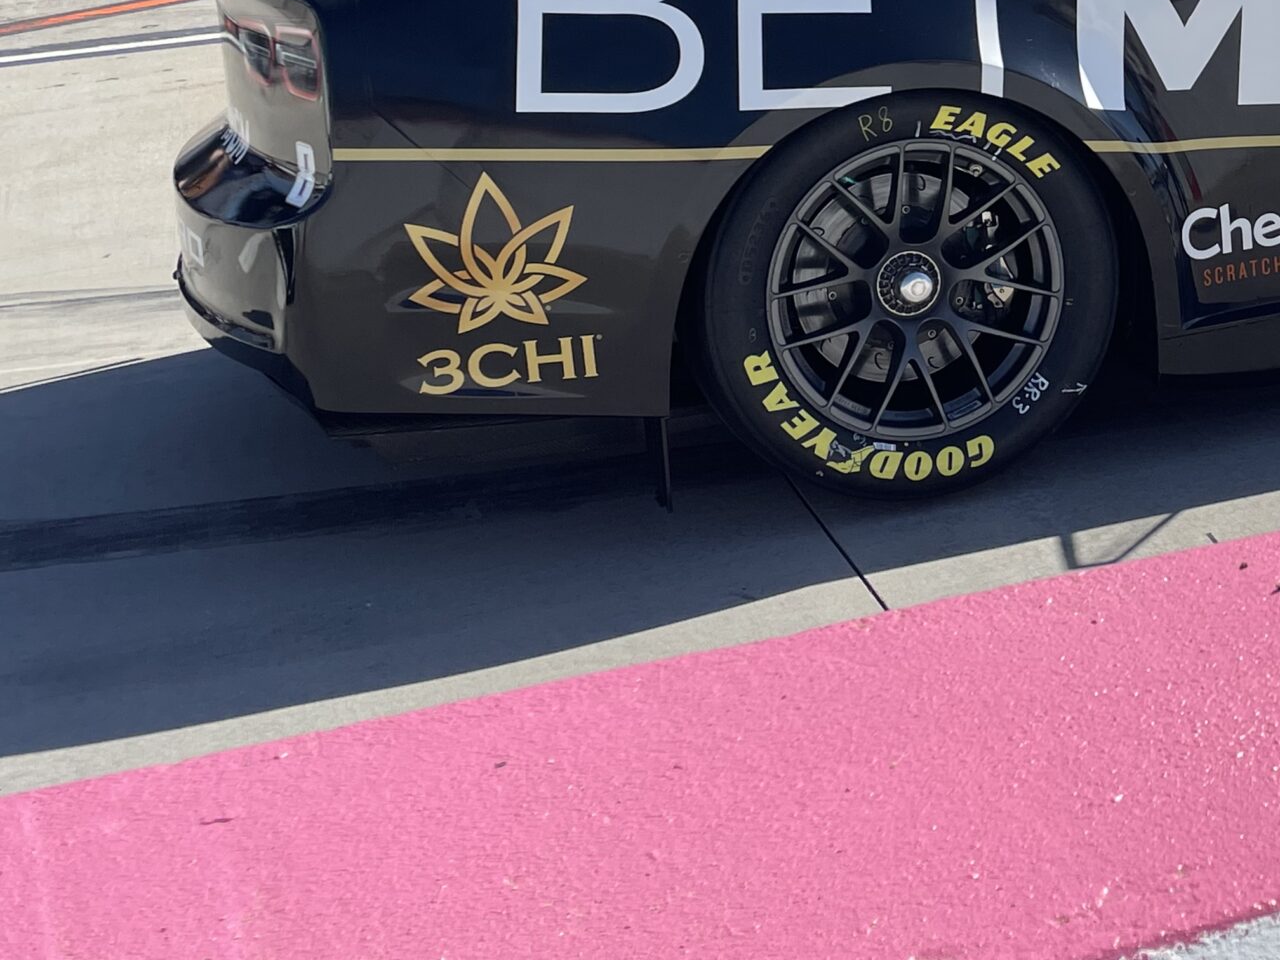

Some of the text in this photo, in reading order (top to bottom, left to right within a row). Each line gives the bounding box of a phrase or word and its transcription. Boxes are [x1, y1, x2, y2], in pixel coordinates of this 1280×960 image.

[857, 106, 893, 141] R8
[929, 105, 1062, 179] EAGLE
[416, 333, 601, 396] 3CHI
[743, 349, 996, 482] GOODYEAR
